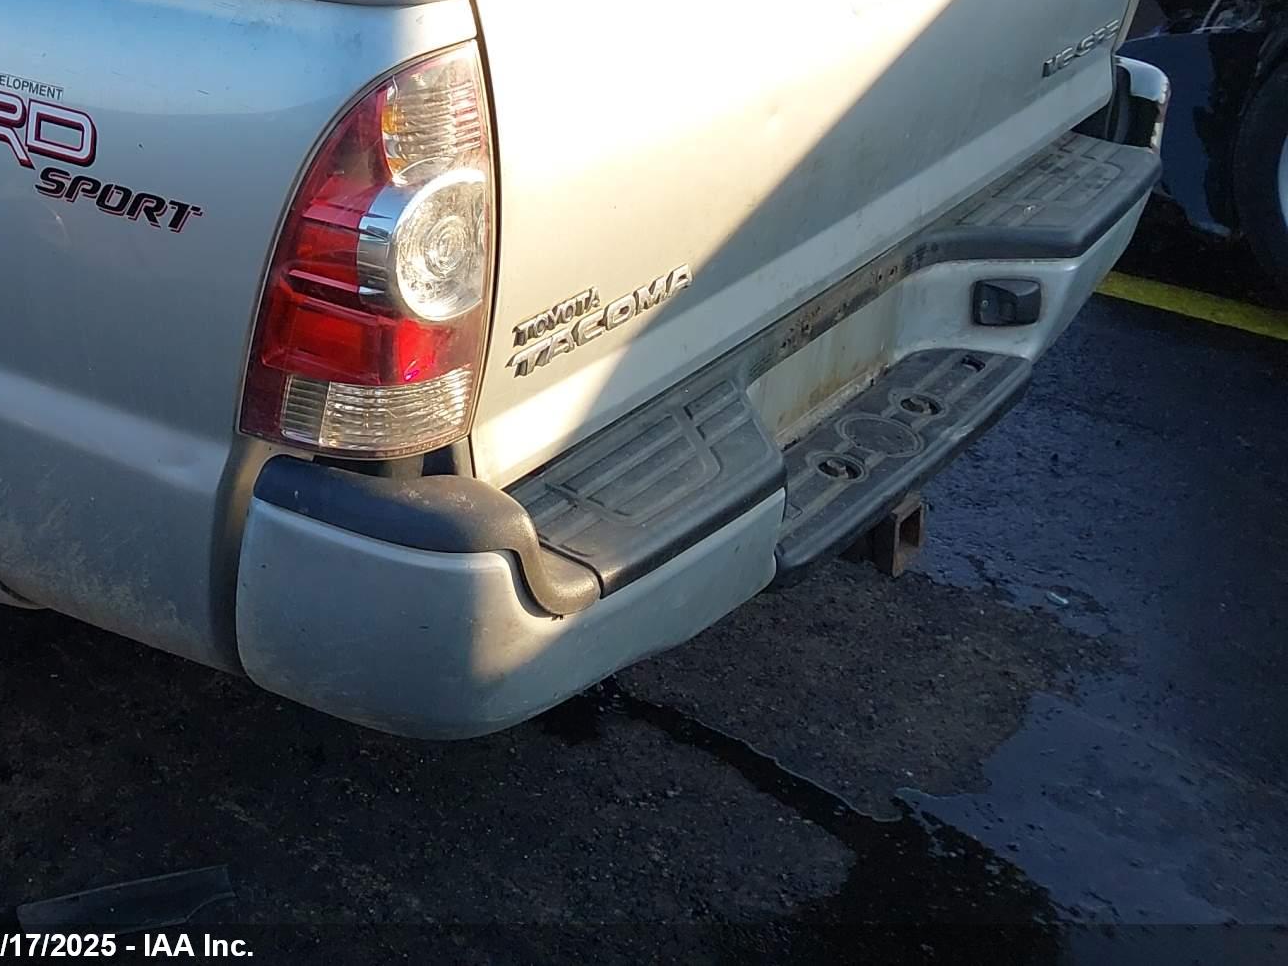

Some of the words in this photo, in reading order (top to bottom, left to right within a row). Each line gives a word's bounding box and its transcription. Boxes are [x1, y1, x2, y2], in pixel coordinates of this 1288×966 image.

[35, 166, 204, 233] SPORT
[505, 263, 695, 378] TACOMA
[511, 286, 601, 348] TOYOTA
